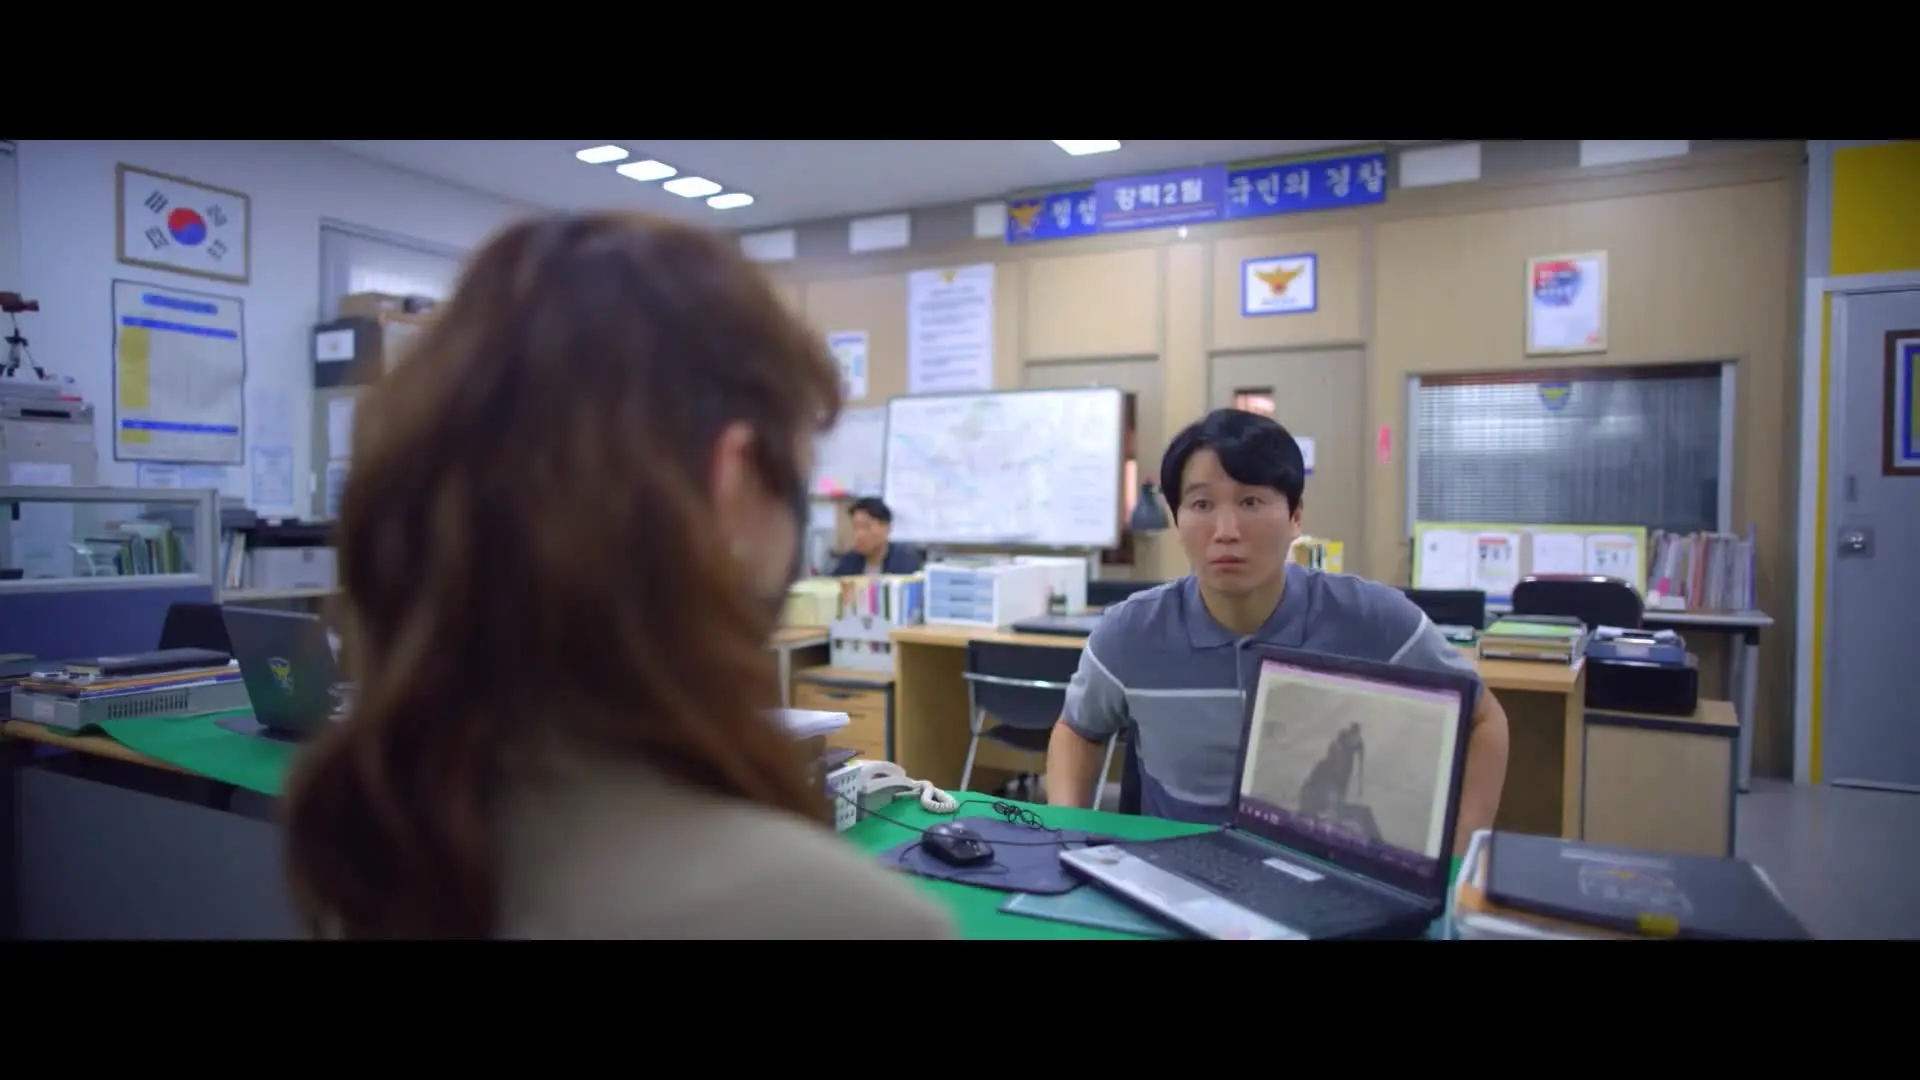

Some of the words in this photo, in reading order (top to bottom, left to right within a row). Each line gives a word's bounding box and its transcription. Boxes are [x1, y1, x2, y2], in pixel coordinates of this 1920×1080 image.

[1114, 178, 1203, 212] 강력2팀
[1226, 168, 1310, 207] 국민의
[1325, 159, 1387, 198] 경찰
